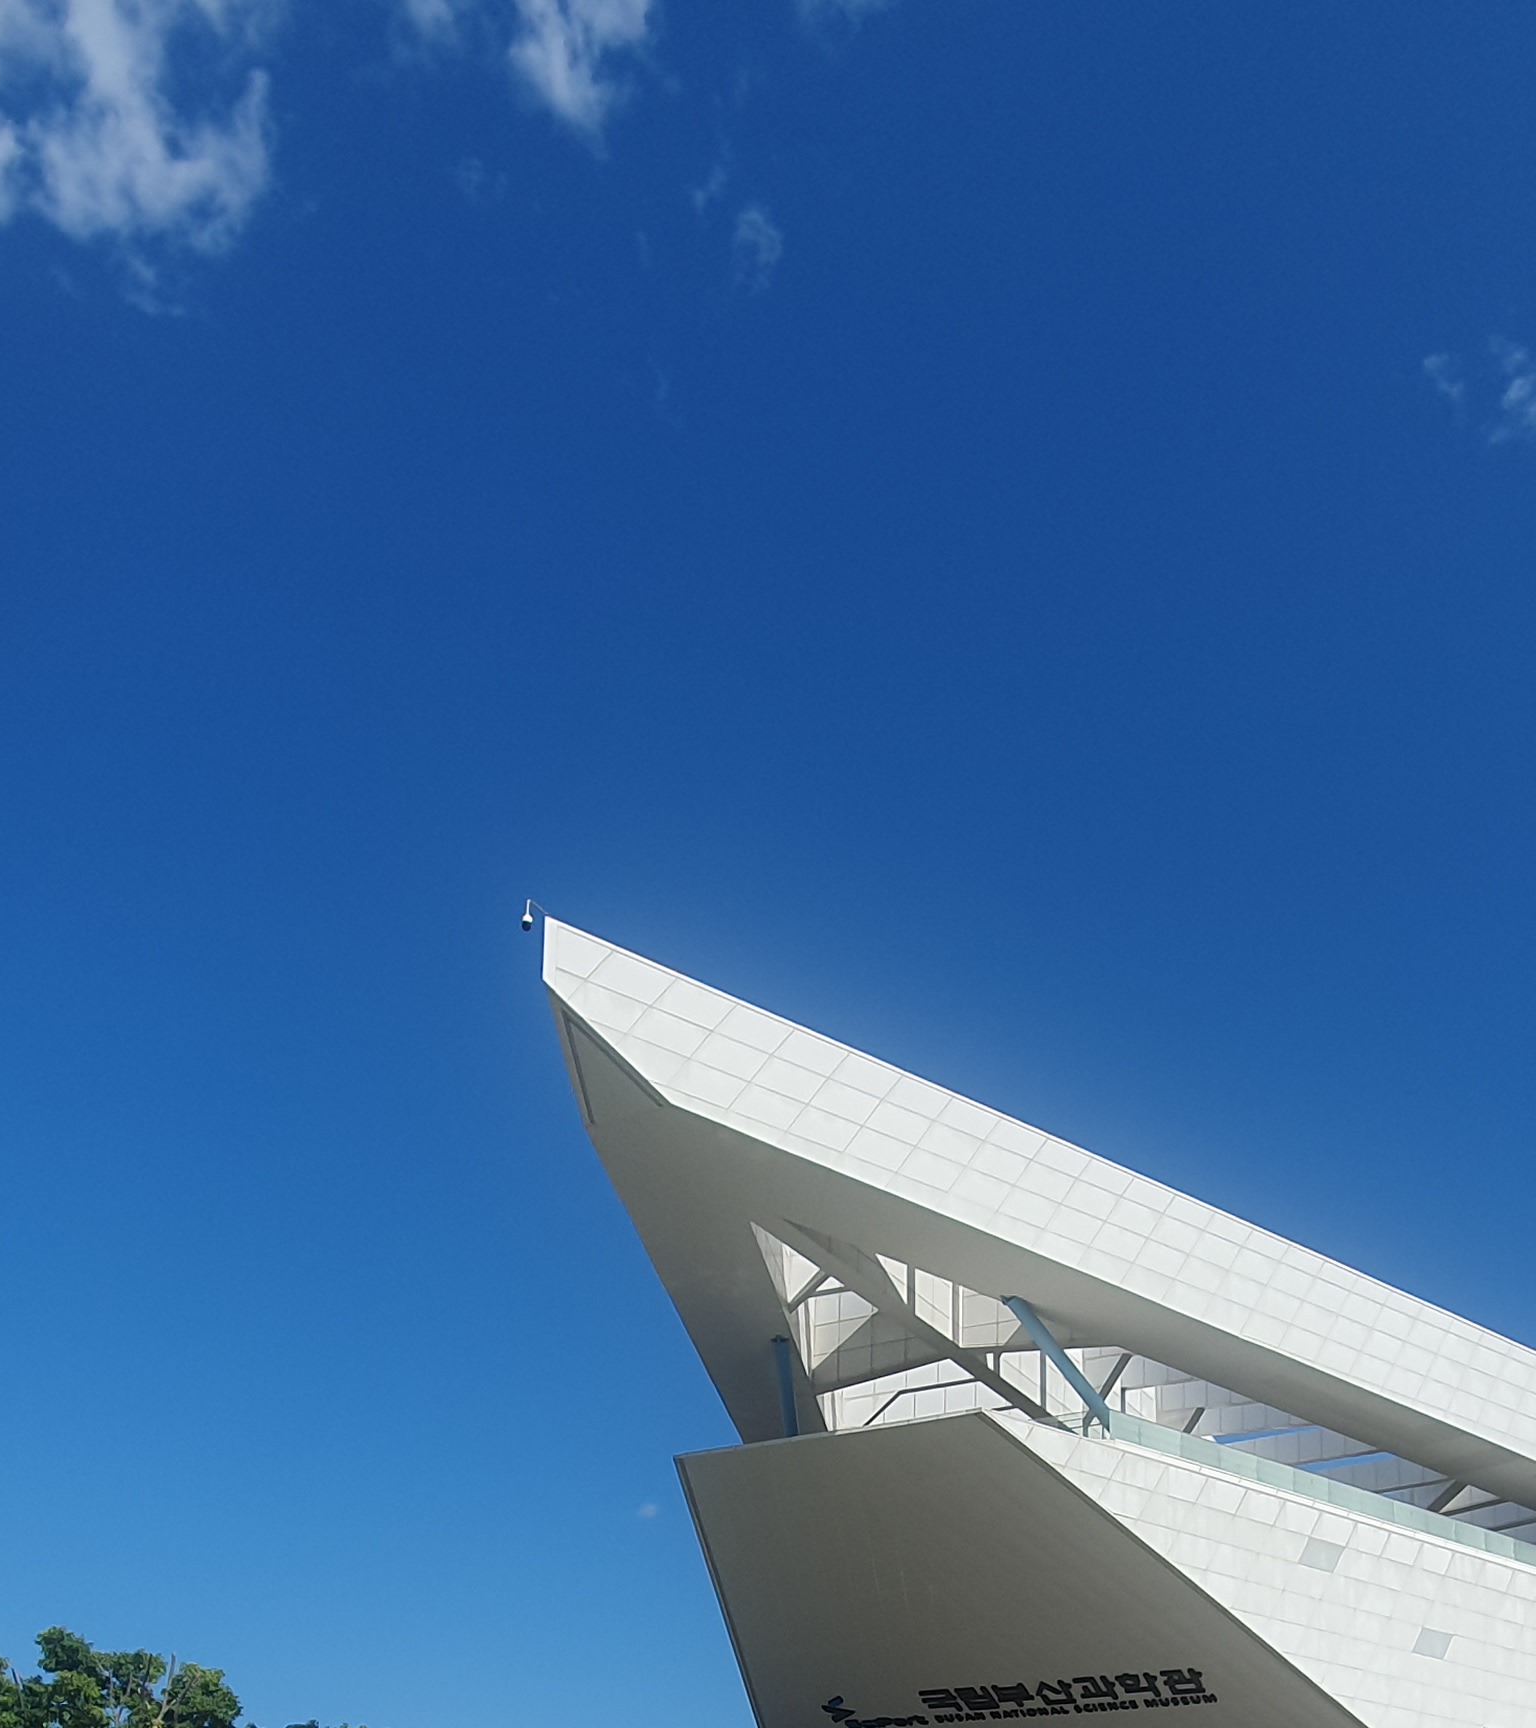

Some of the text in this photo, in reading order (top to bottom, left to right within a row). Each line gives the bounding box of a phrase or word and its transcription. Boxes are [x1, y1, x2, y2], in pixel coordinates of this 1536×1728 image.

[918, 1667, 1206, 1712] 국립부산과학관
[990, 1705, 1070, 1719] NATIONAL
[1073, 1699, 1139, 1714] SCIENCE
[1144, 1692, 1218, 1708] MUSEUM
